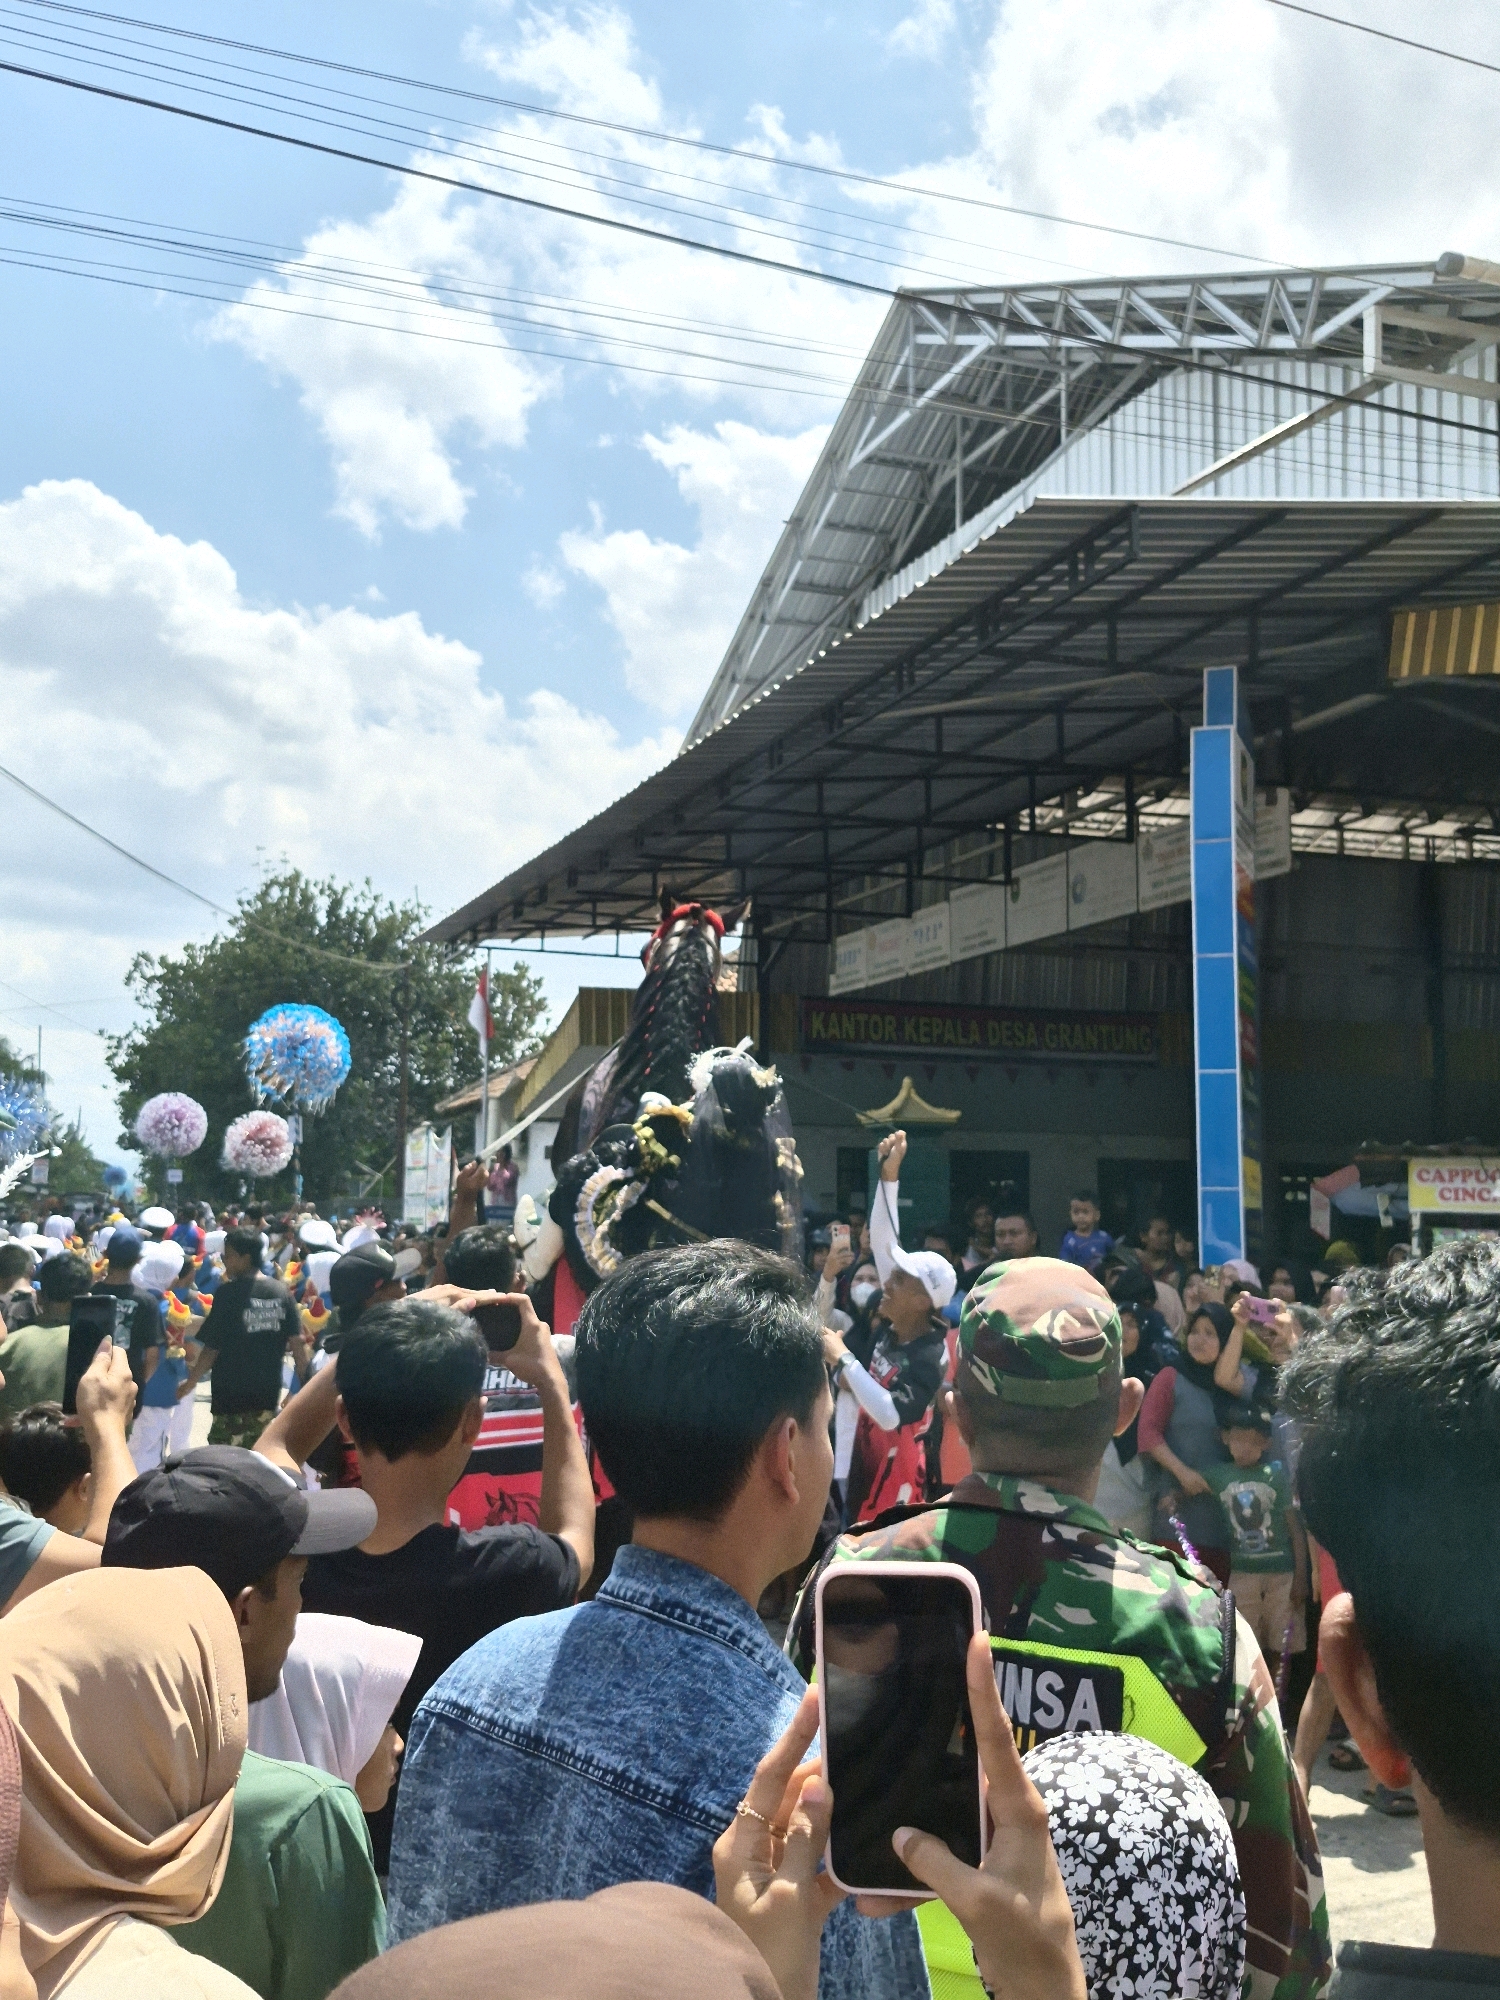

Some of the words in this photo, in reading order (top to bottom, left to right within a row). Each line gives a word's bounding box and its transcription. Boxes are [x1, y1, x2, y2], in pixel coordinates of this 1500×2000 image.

[811, 1010, 897, 1041] KANTOR
[904, 1015, 980, 1045] KEPALA
[987, 1020, 1038, 1047] DESA
[1044, 1023, 1151, 1052] GRANTUNG
[1438, 1186, 1498, 1202] CINC
